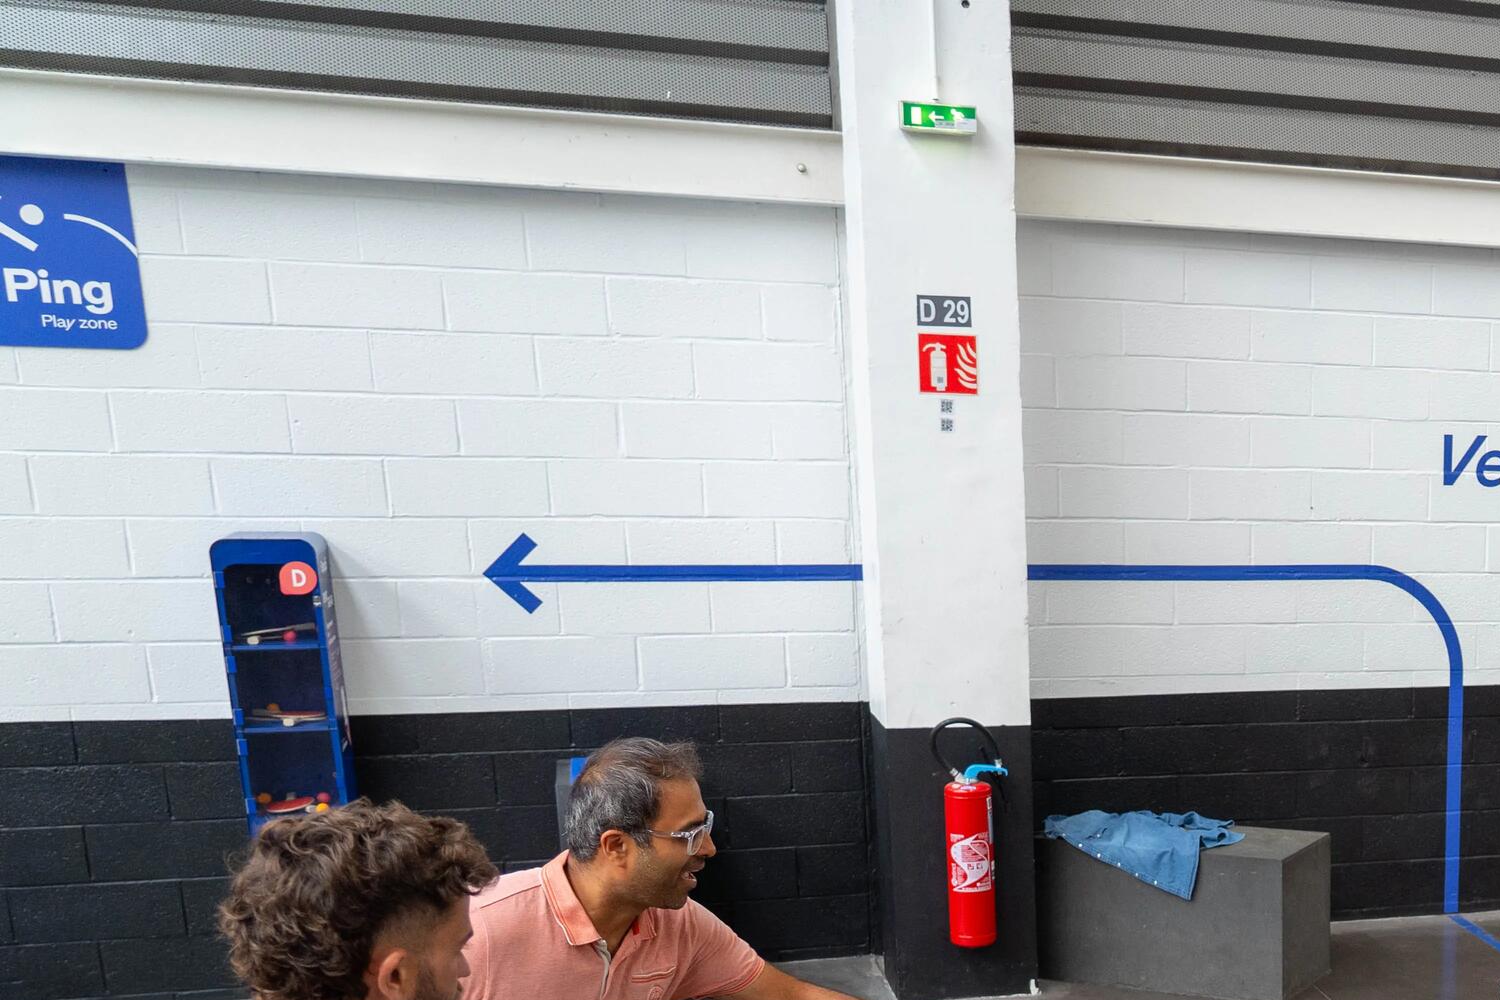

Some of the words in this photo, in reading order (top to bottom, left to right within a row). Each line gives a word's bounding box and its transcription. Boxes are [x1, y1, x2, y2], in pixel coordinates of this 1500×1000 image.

[3, 267, 114, 315] Ping
[919, 299, 936, 322] D
[943, 300, 970, 323] 29
[41, 314, 76, 331] Play
[79, 318, 118, 330] zone
[291, 569, 307, 588] D
